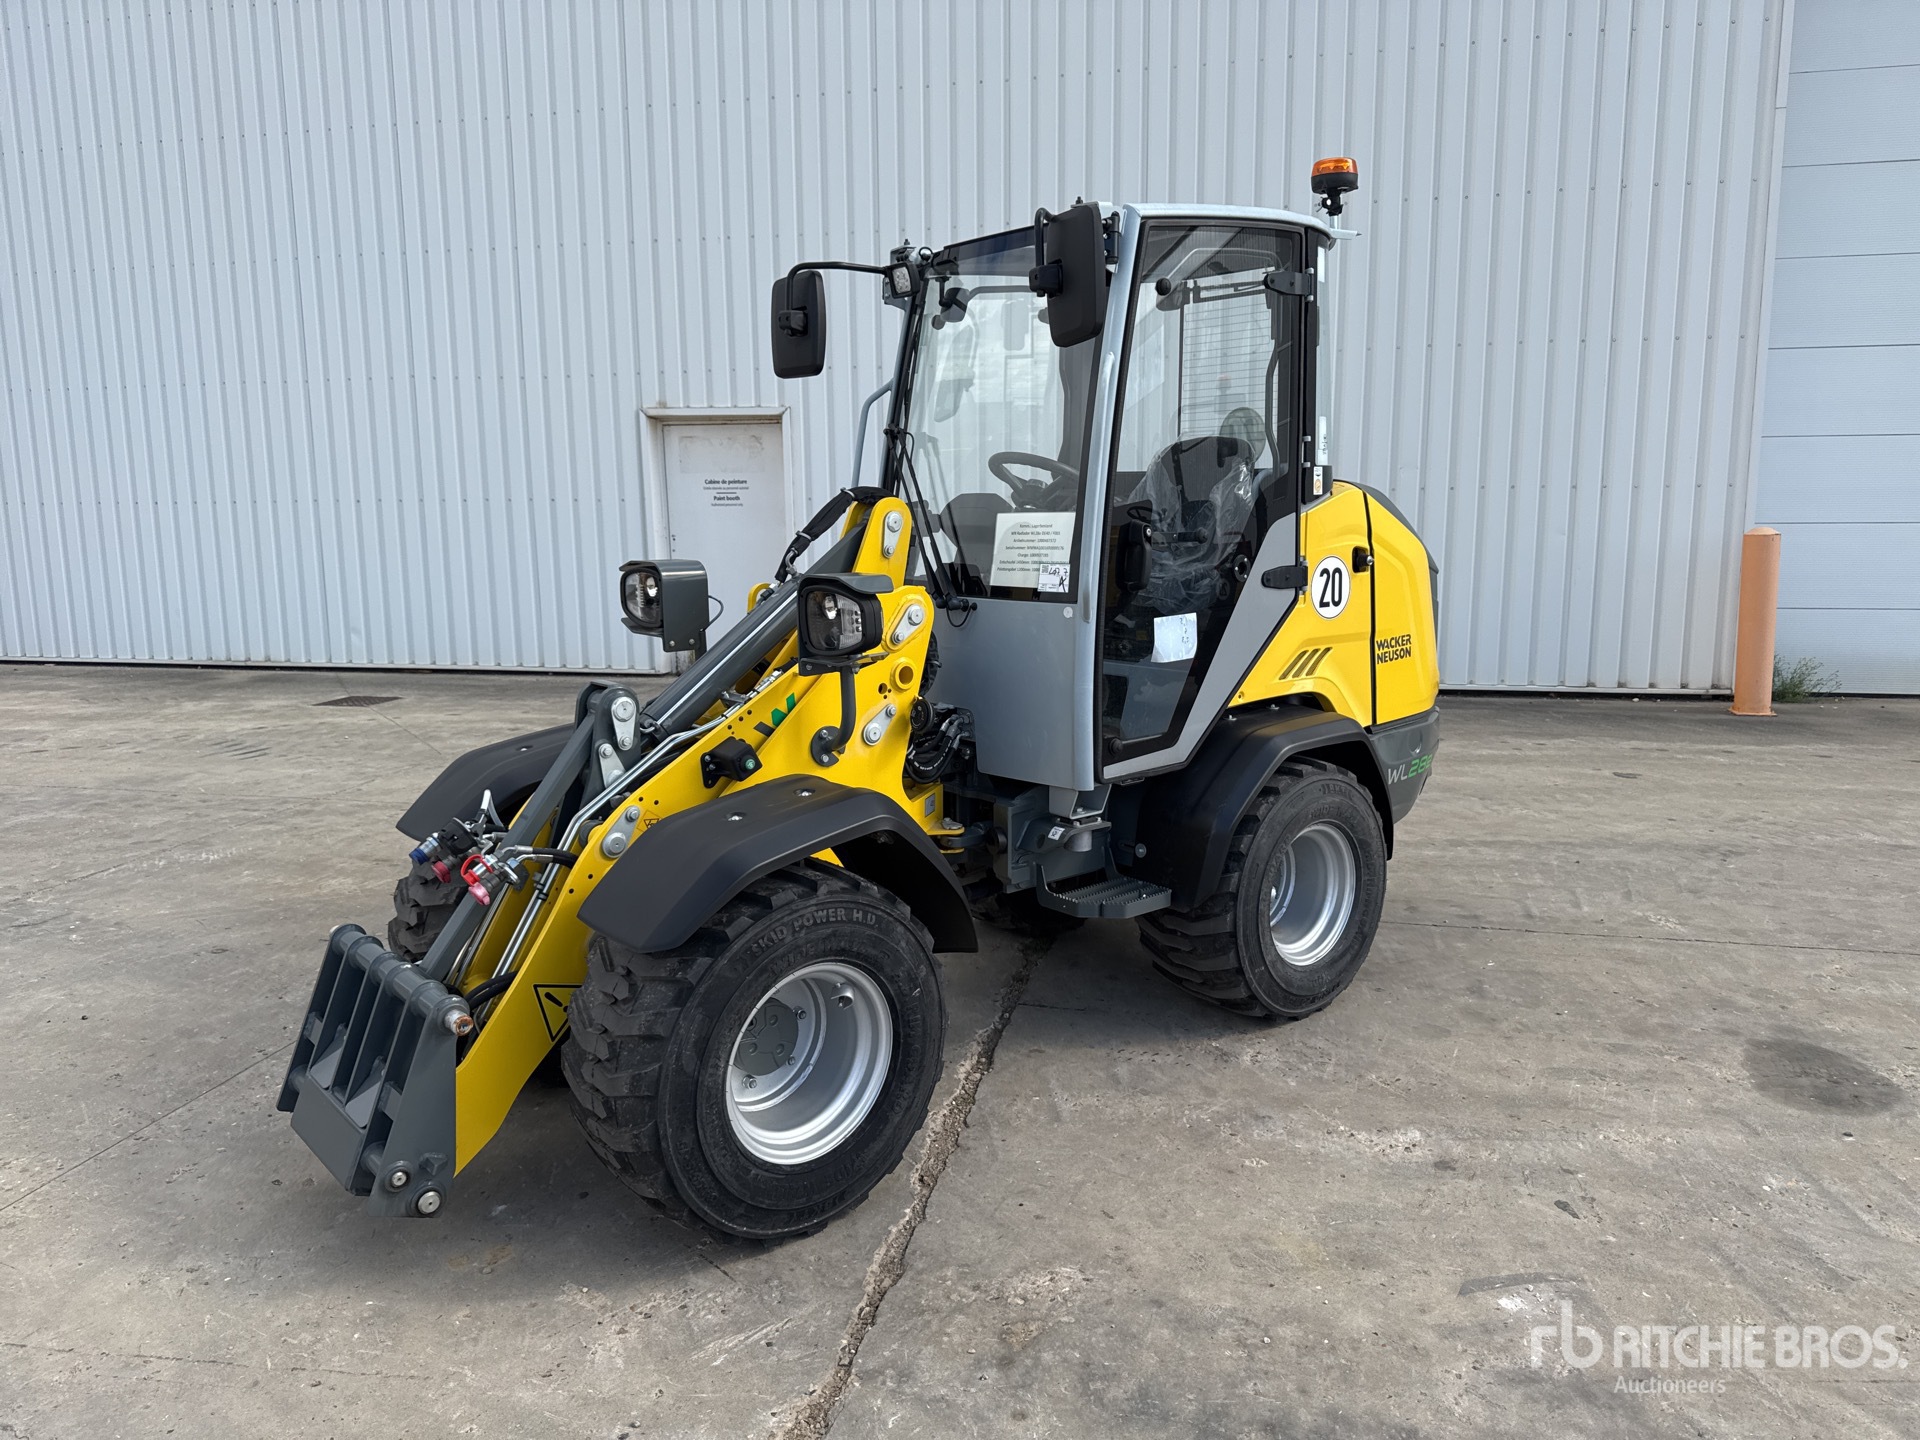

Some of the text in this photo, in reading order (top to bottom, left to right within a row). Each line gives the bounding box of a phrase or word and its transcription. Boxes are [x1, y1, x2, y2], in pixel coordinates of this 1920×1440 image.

[1318, 567, 1343, 608] 20
[1376, 634, 1412, 651] WACKER
[1376, 646, 1412, 665] NEUSON
[750, 925, 788, 957] SKID
[793, 908, 847, 931] POWER
